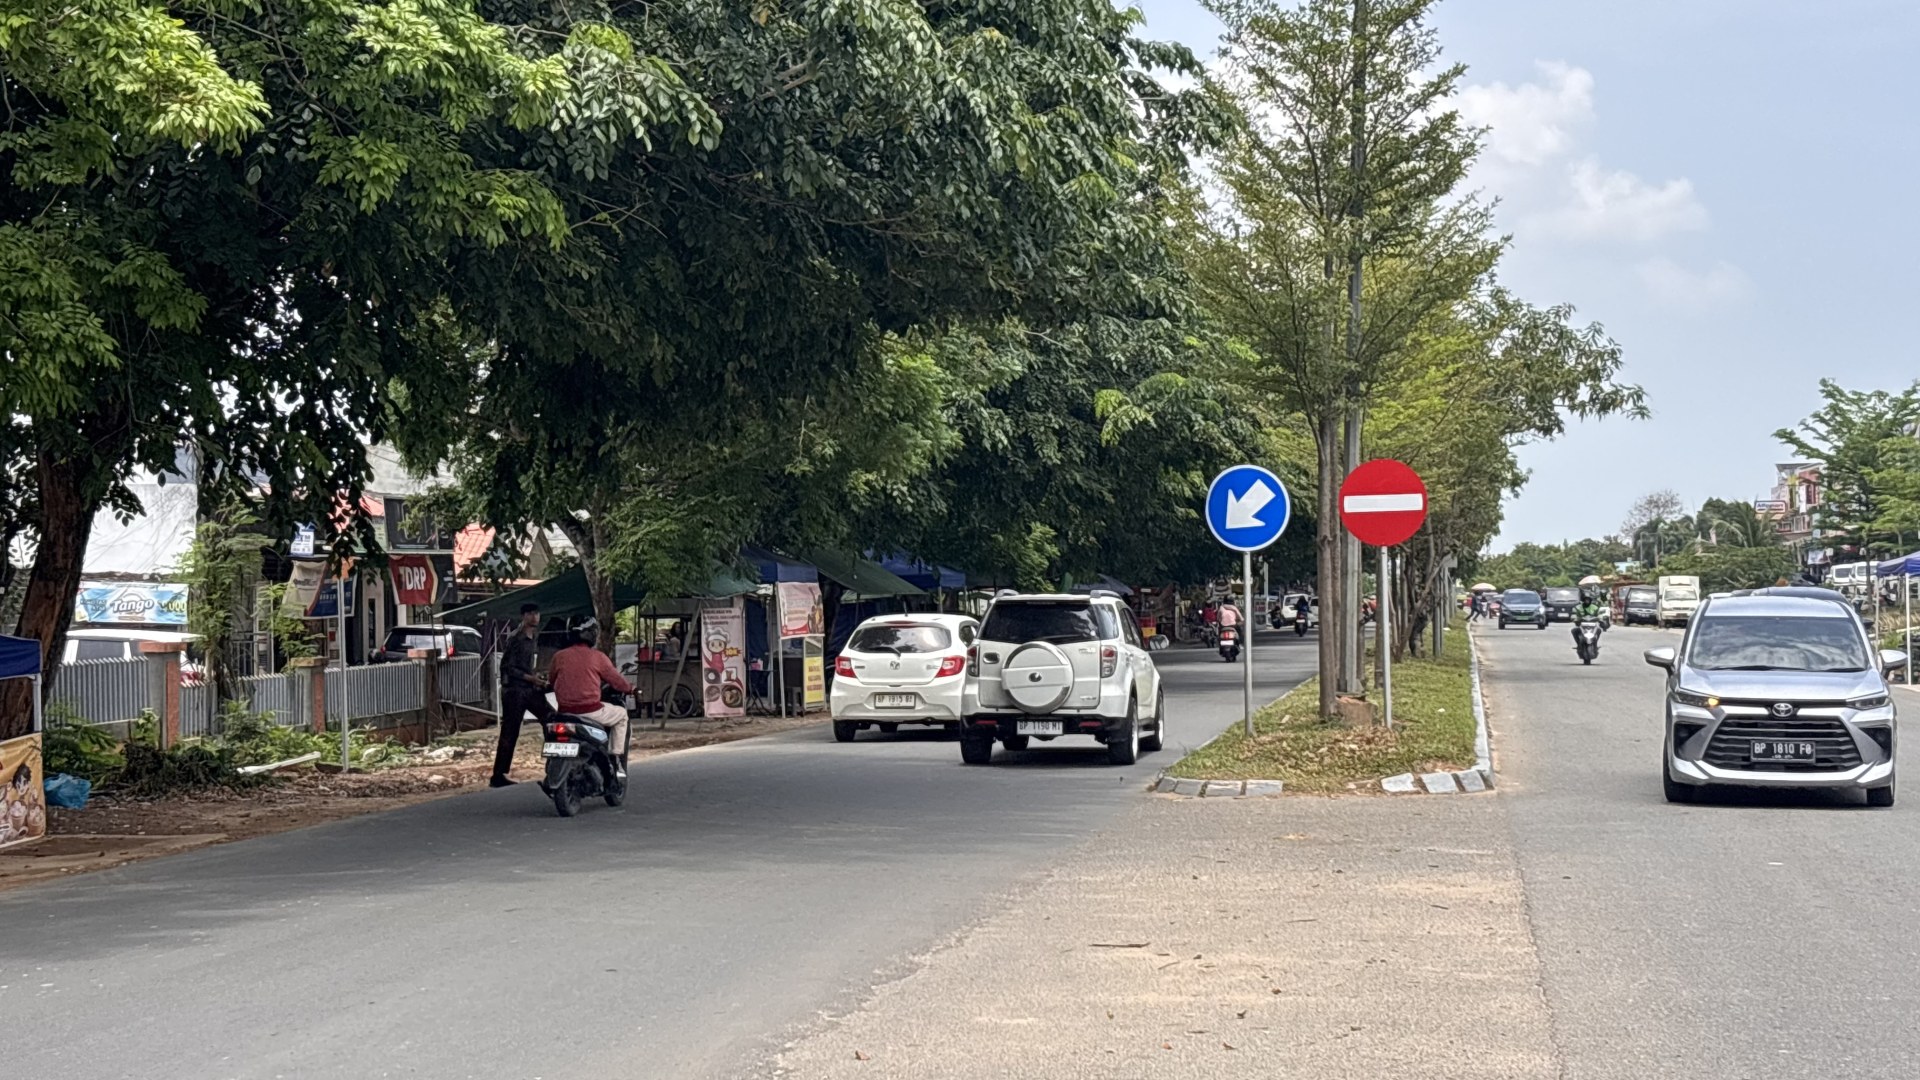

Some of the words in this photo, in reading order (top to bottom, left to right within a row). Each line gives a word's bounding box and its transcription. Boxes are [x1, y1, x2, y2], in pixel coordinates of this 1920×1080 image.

[111, 599, 155, 613] Tango
[1019, 721, 1029, 731] BP
[1754, 742, 1766, 754] BP
[1772, 742, 1795, 754] 1810
